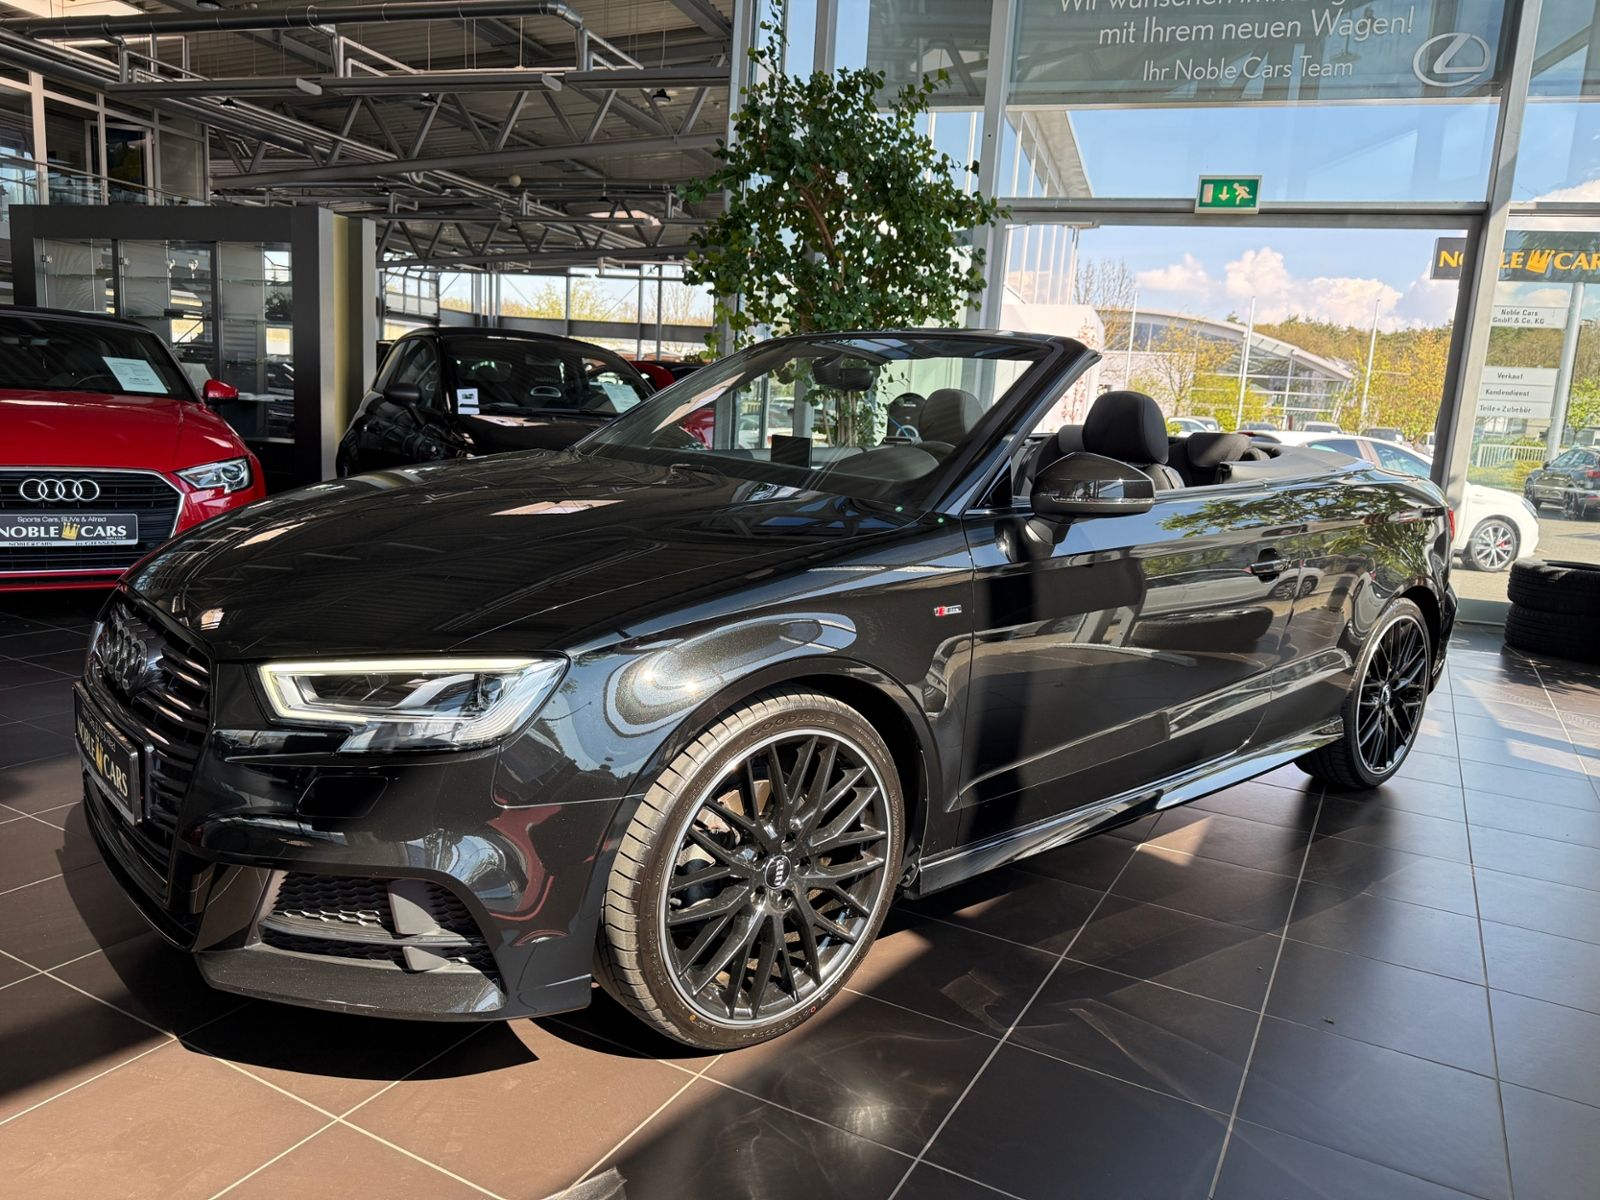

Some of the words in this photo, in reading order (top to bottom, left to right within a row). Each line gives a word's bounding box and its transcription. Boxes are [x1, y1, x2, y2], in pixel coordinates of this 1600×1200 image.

[1099, 22, 1136, 45] mit
[1143, 16, 1214, 43] Ihrem
[1221, 19, 1301, 40] neuen
[1311, 5, 1414, 42] Wagen!
[1143, 60, 1169, 81] Ihr
[1174, 57, 1237, 80] Noble
[1243, 56, 1292, 78] Cars
[1299, 55, 1353, 77] Team
[1498, 372, 1524, 380] Verkauf
[1485, 389, 1530, 397] Kundendienst
[0, 526, 59, 538] NOBLE
[80, 525, 127, 537] CARS
[103, 753, 128, 797] CARS
